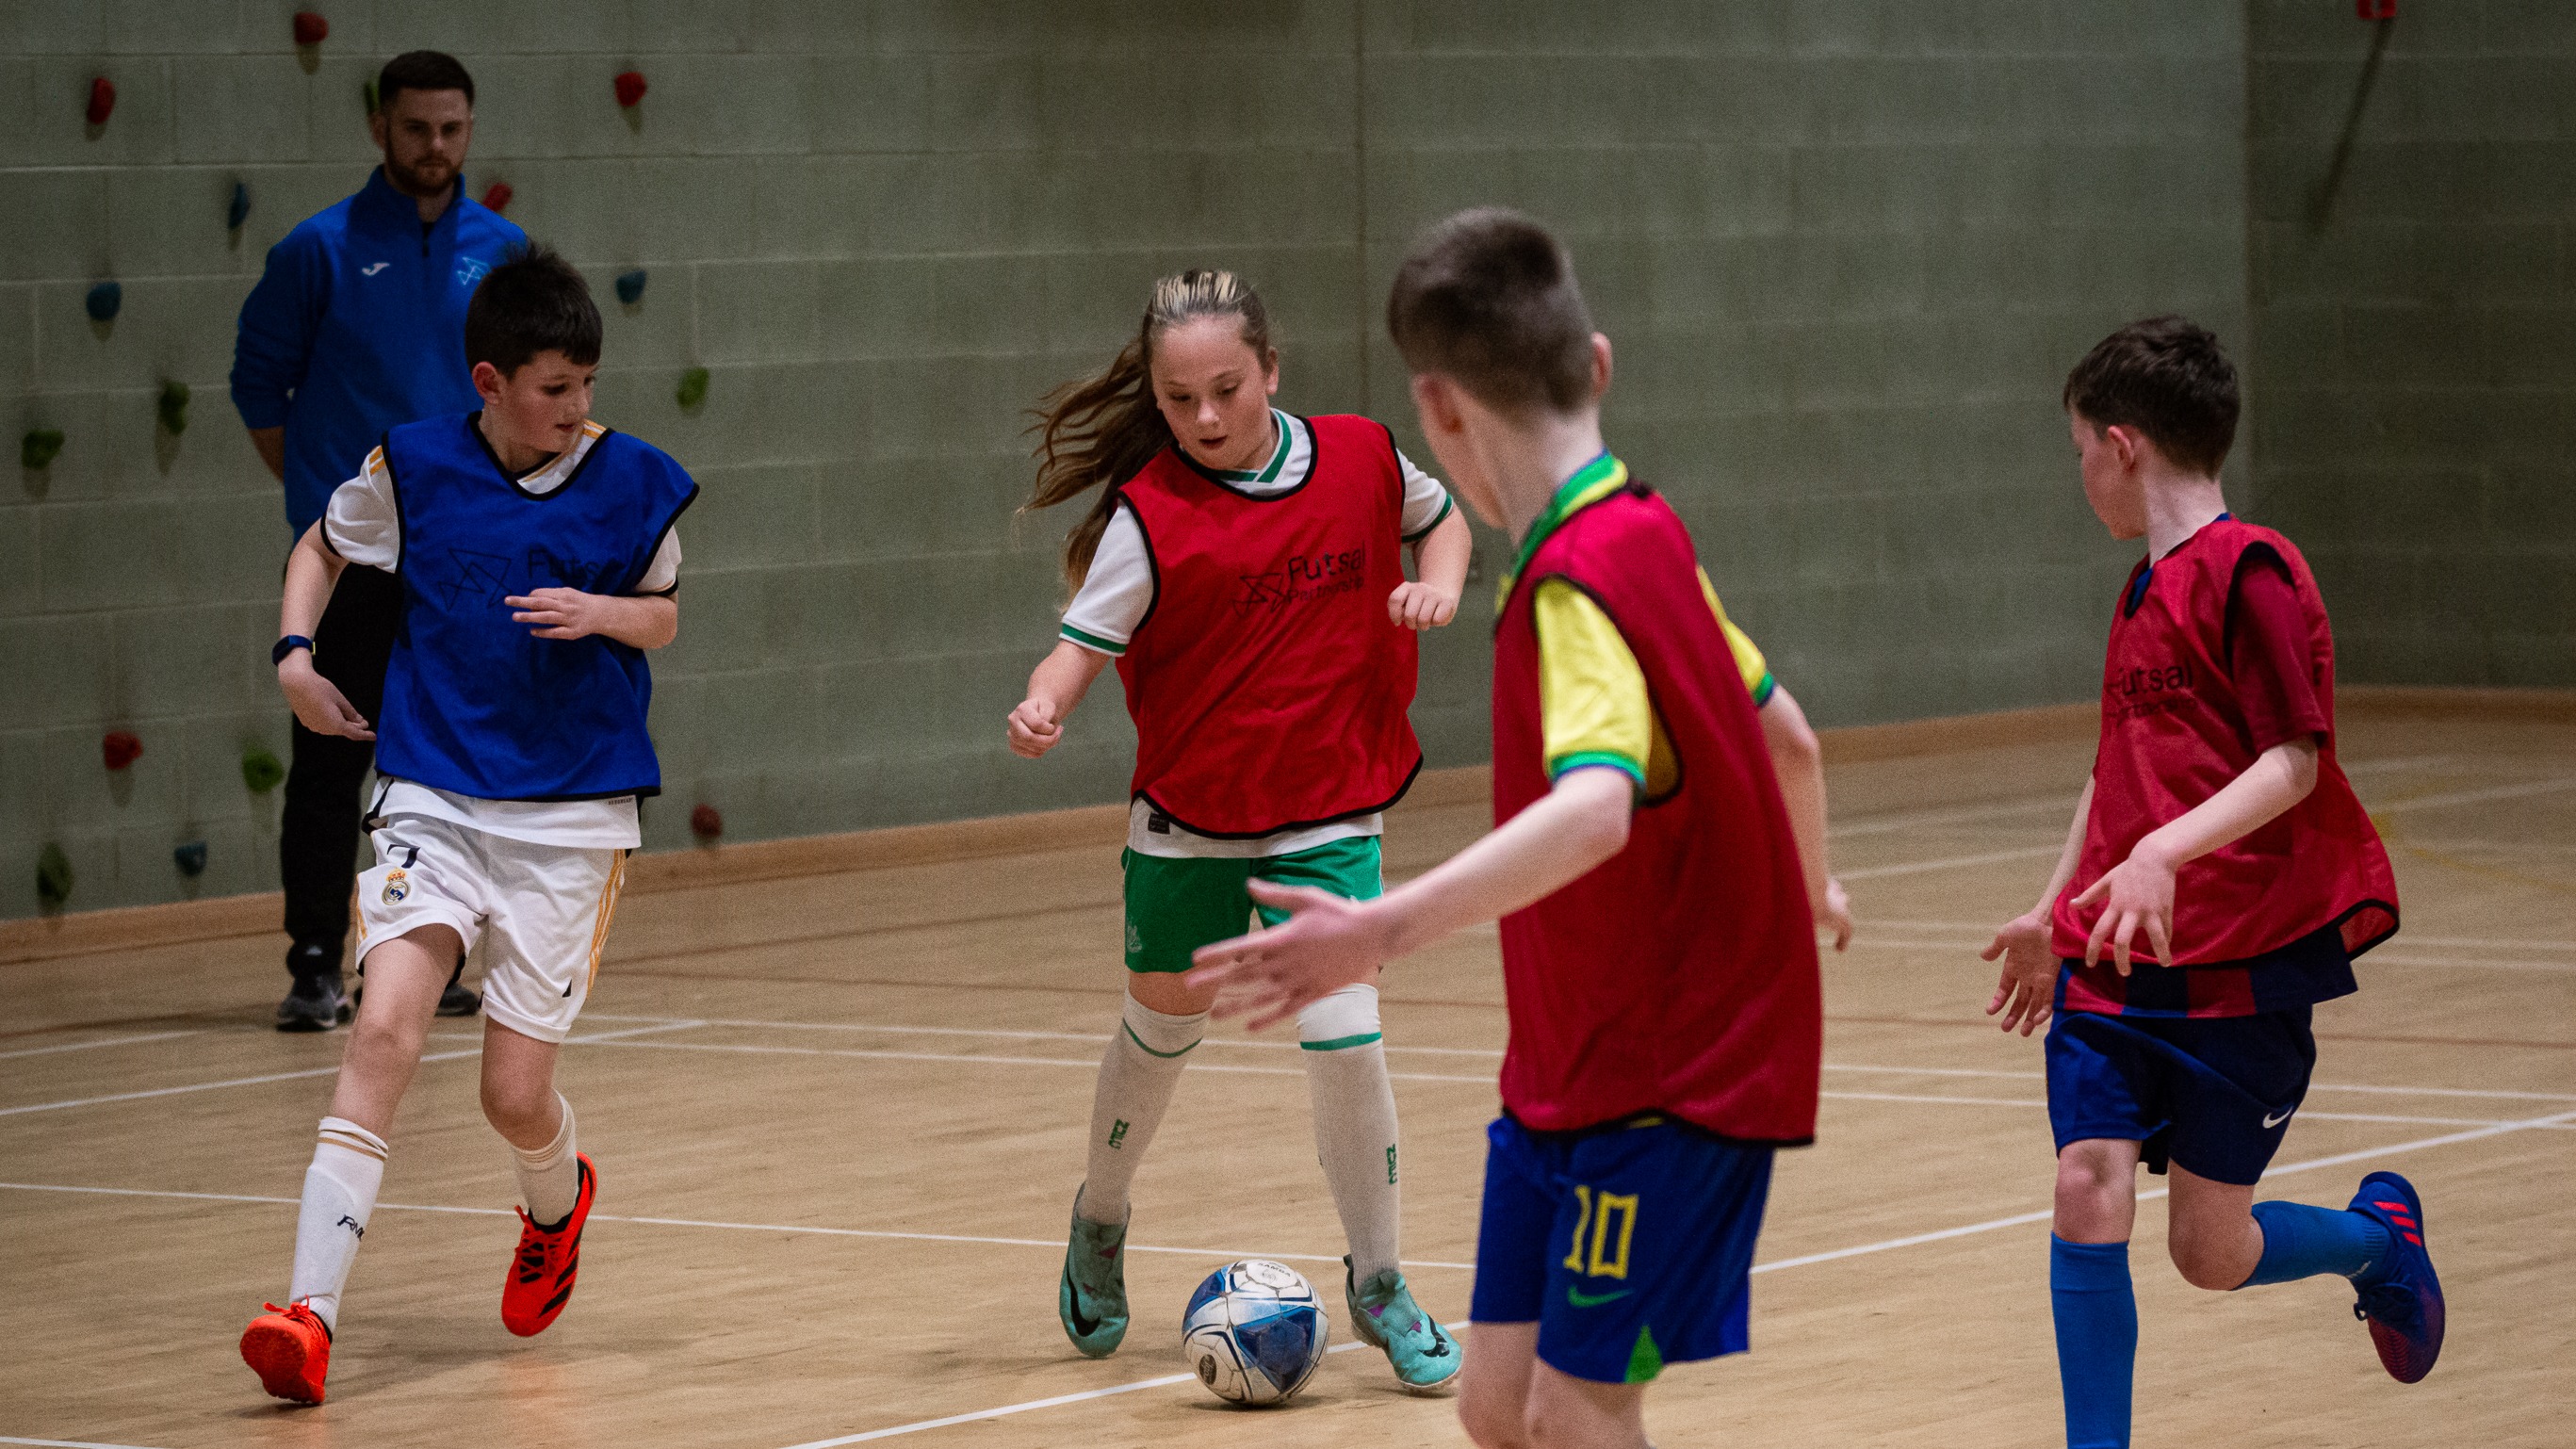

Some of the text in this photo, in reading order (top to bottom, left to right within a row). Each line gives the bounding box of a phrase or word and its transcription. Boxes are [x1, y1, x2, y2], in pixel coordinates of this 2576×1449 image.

[1287, 541, 1365, 581] Futsal
[386, 844, 421, 869] 7
[1562, 1184, 1639, 1280] 10
